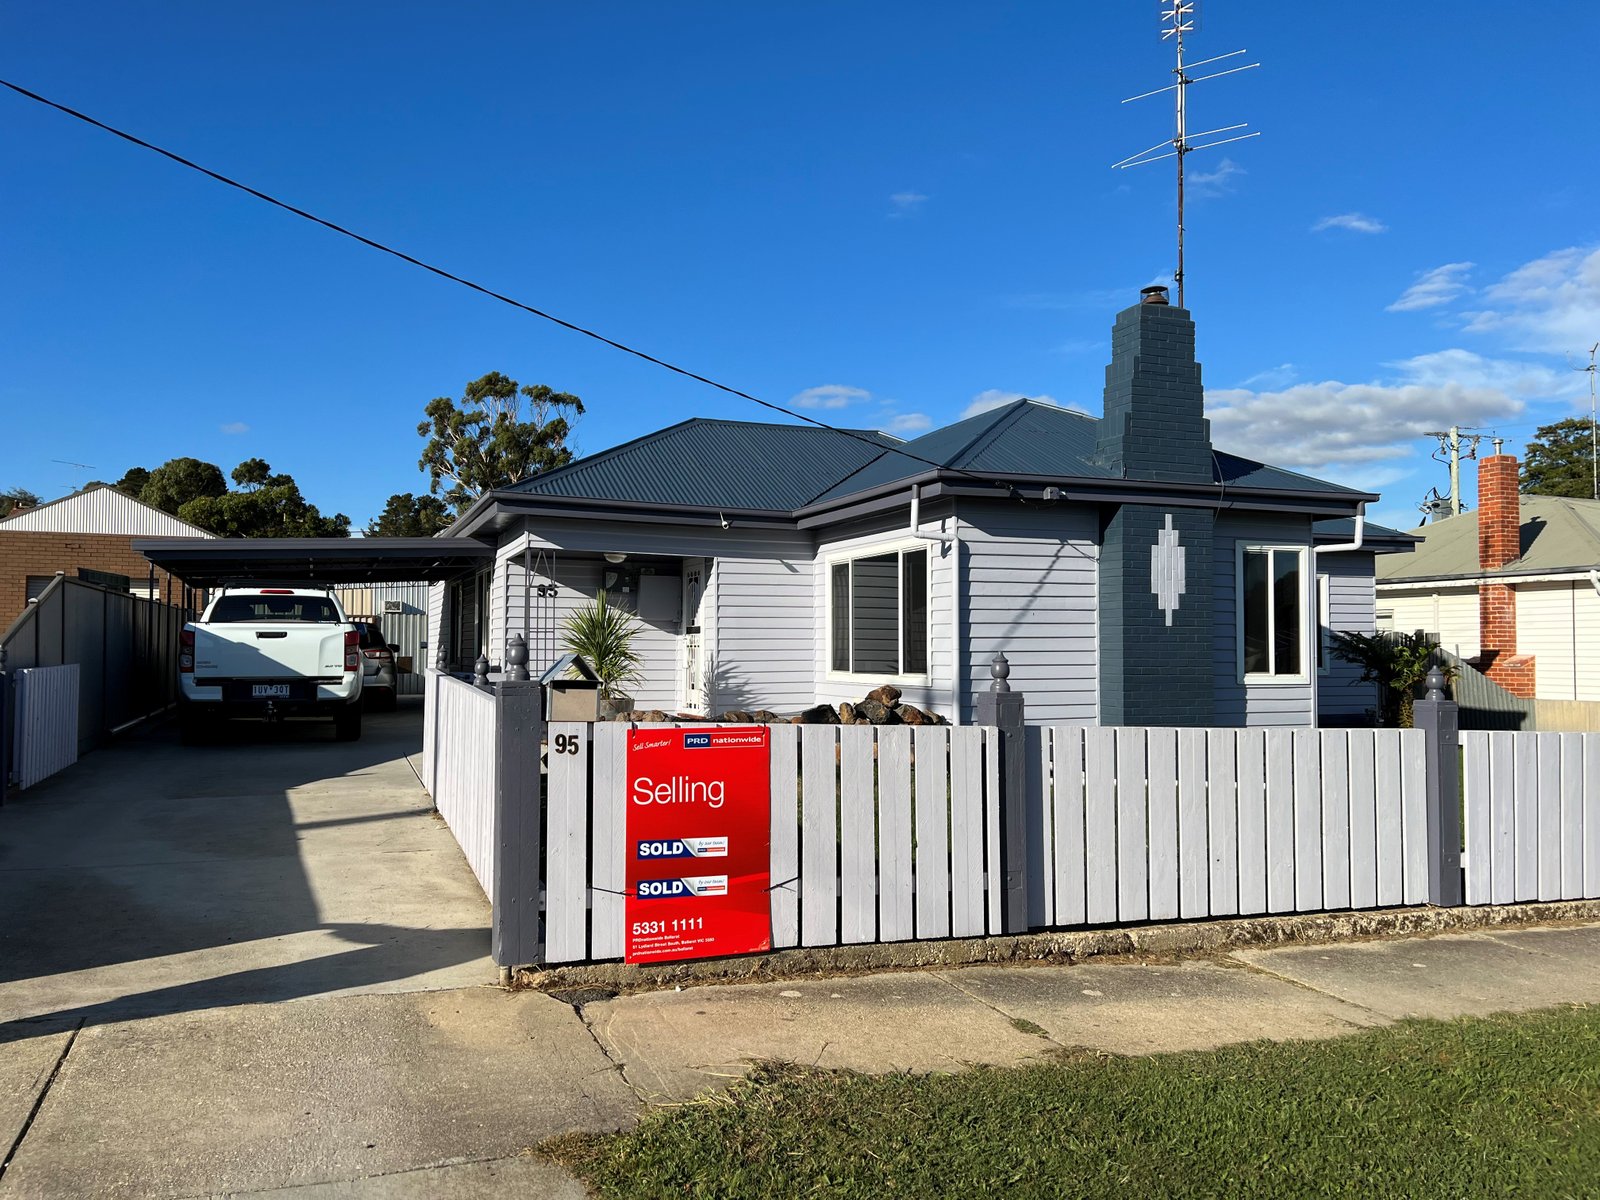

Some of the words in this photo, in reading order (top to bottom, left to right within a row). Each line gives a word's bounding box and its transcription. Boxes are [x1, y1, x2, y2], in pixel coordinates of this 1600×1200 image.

[538, 584, 558, 598] 95
[555, 733, 579, 755] 95
[633, 742, 644, 752] Sell
[644, 739, 672, 749] Smarter!
[712, 736, 762, 744] nationwide
[633, 776, 724, 808] Selling
[639, 842, 684, 856] SOLD
[639, 881, 683, 895] SOLD
[632, 920, 665, 935] 5331
[672, 917, 703, 931] 1111
